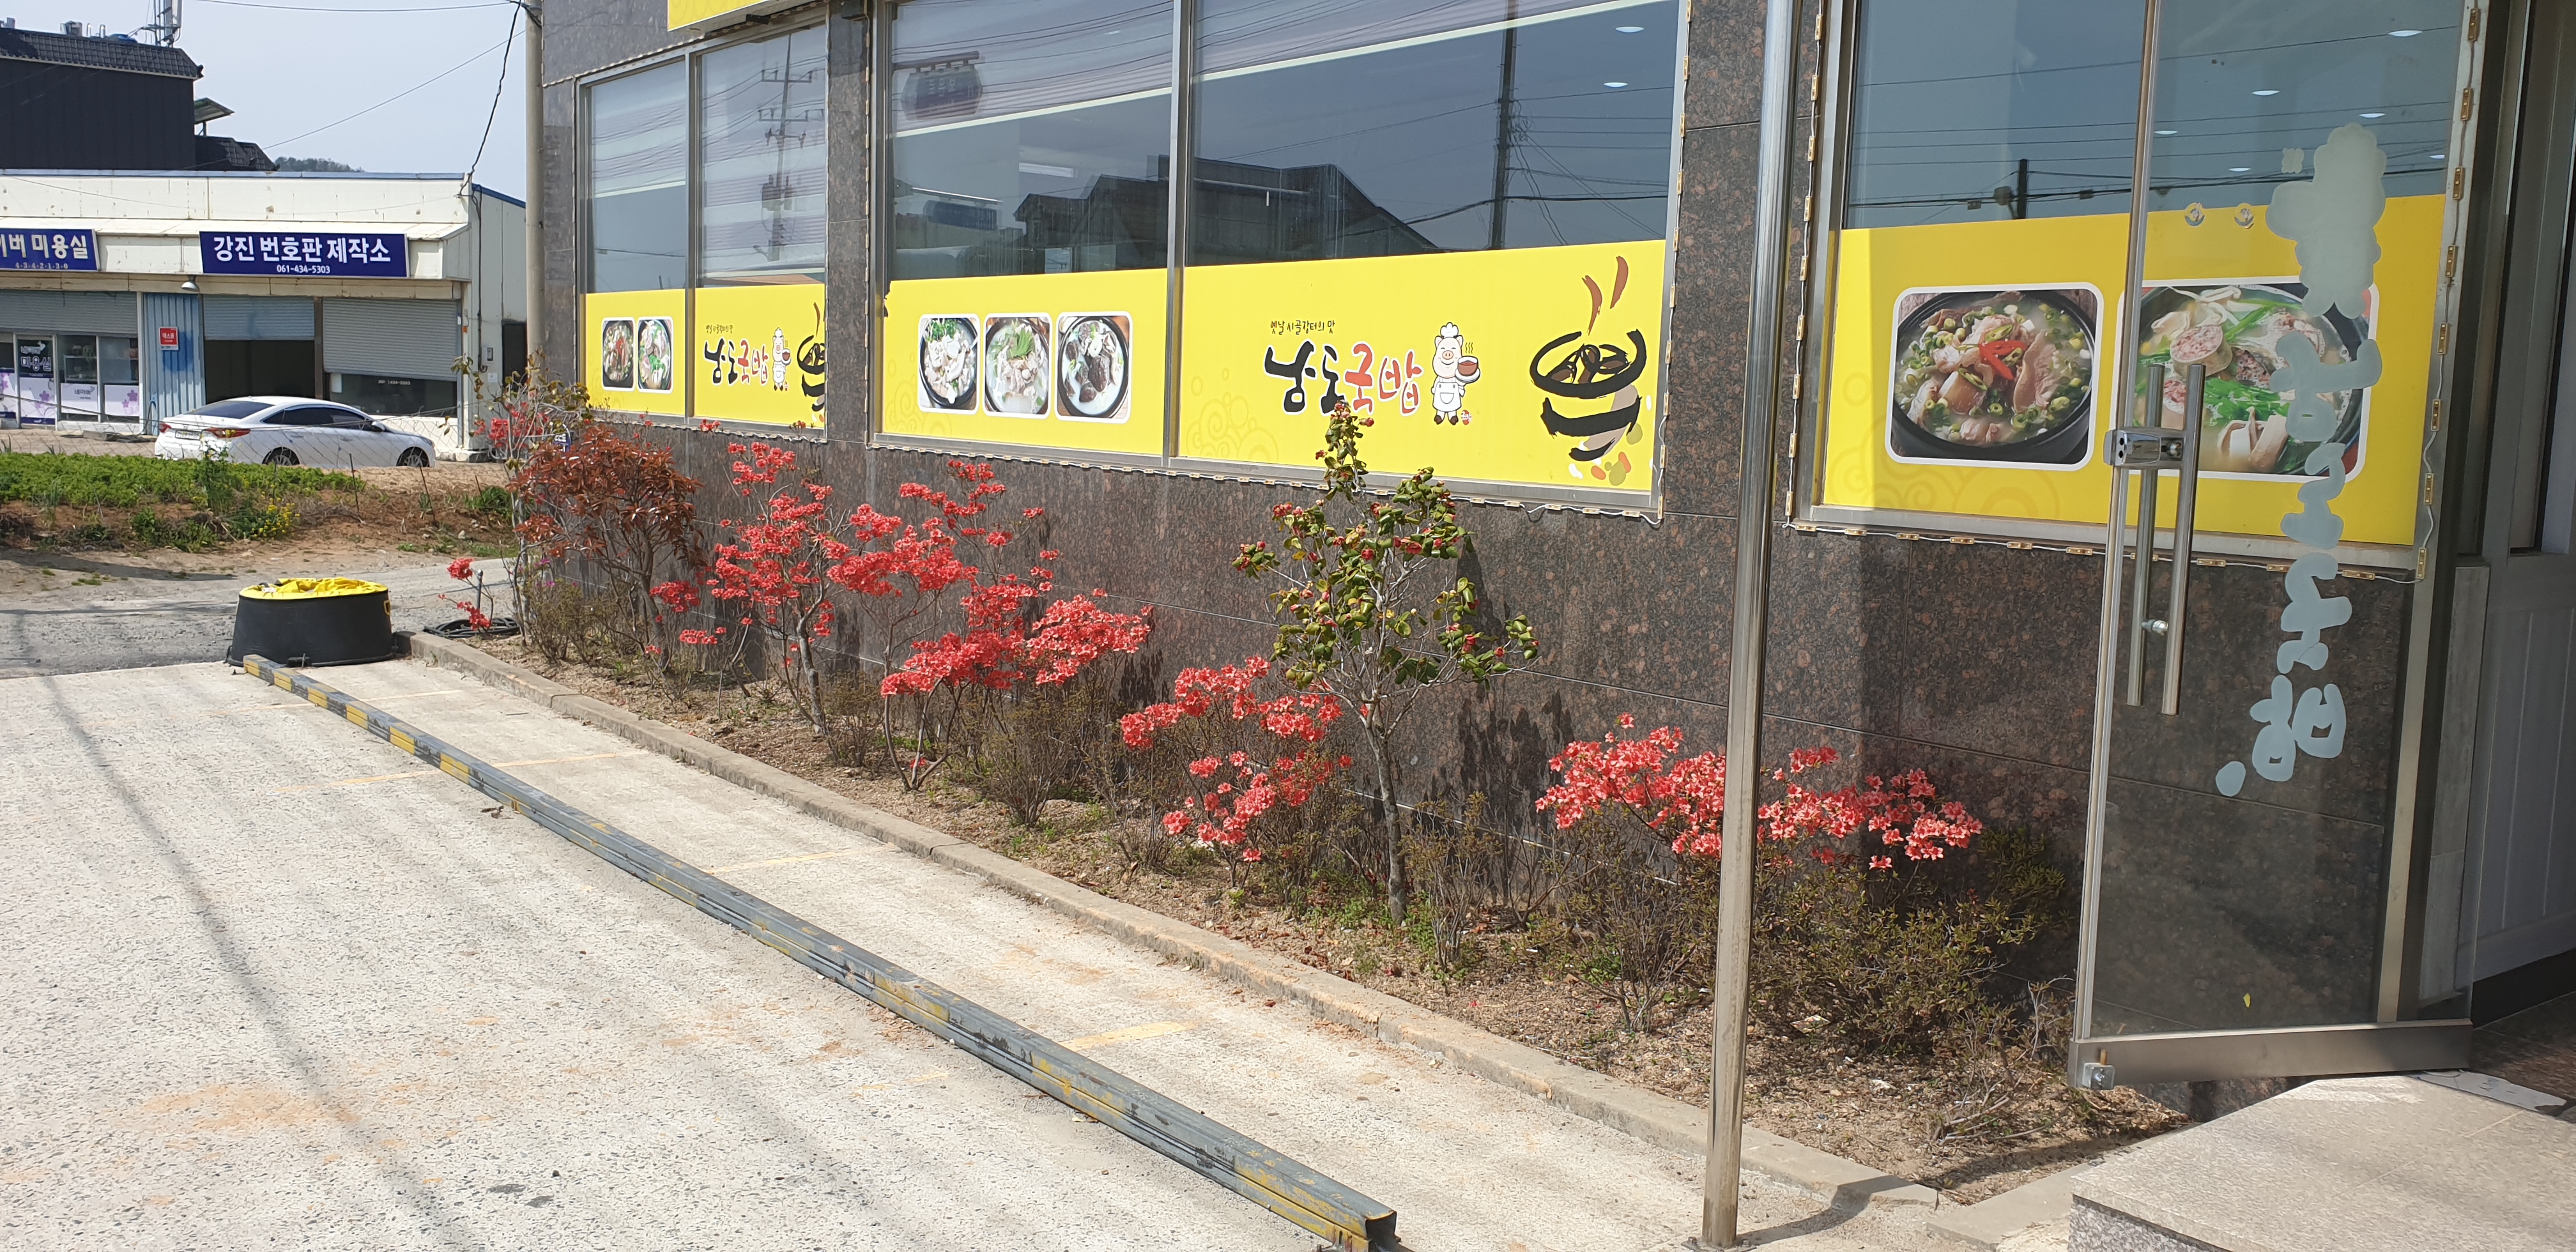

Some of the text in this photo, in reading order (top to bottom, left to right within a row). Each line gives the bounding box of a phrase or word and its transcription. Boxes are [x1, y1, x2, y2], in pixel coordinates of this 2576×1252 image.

[31, 234, 88, 259] 미용실
[213, 236, 391, 264] 강진 번호판 제작소
[277, 264, 330, 274] 061-434-5303
[1270, 319, 1336, 335] 옛날 시골장터의 맛
[20, 356, 51, 372] 미용실
